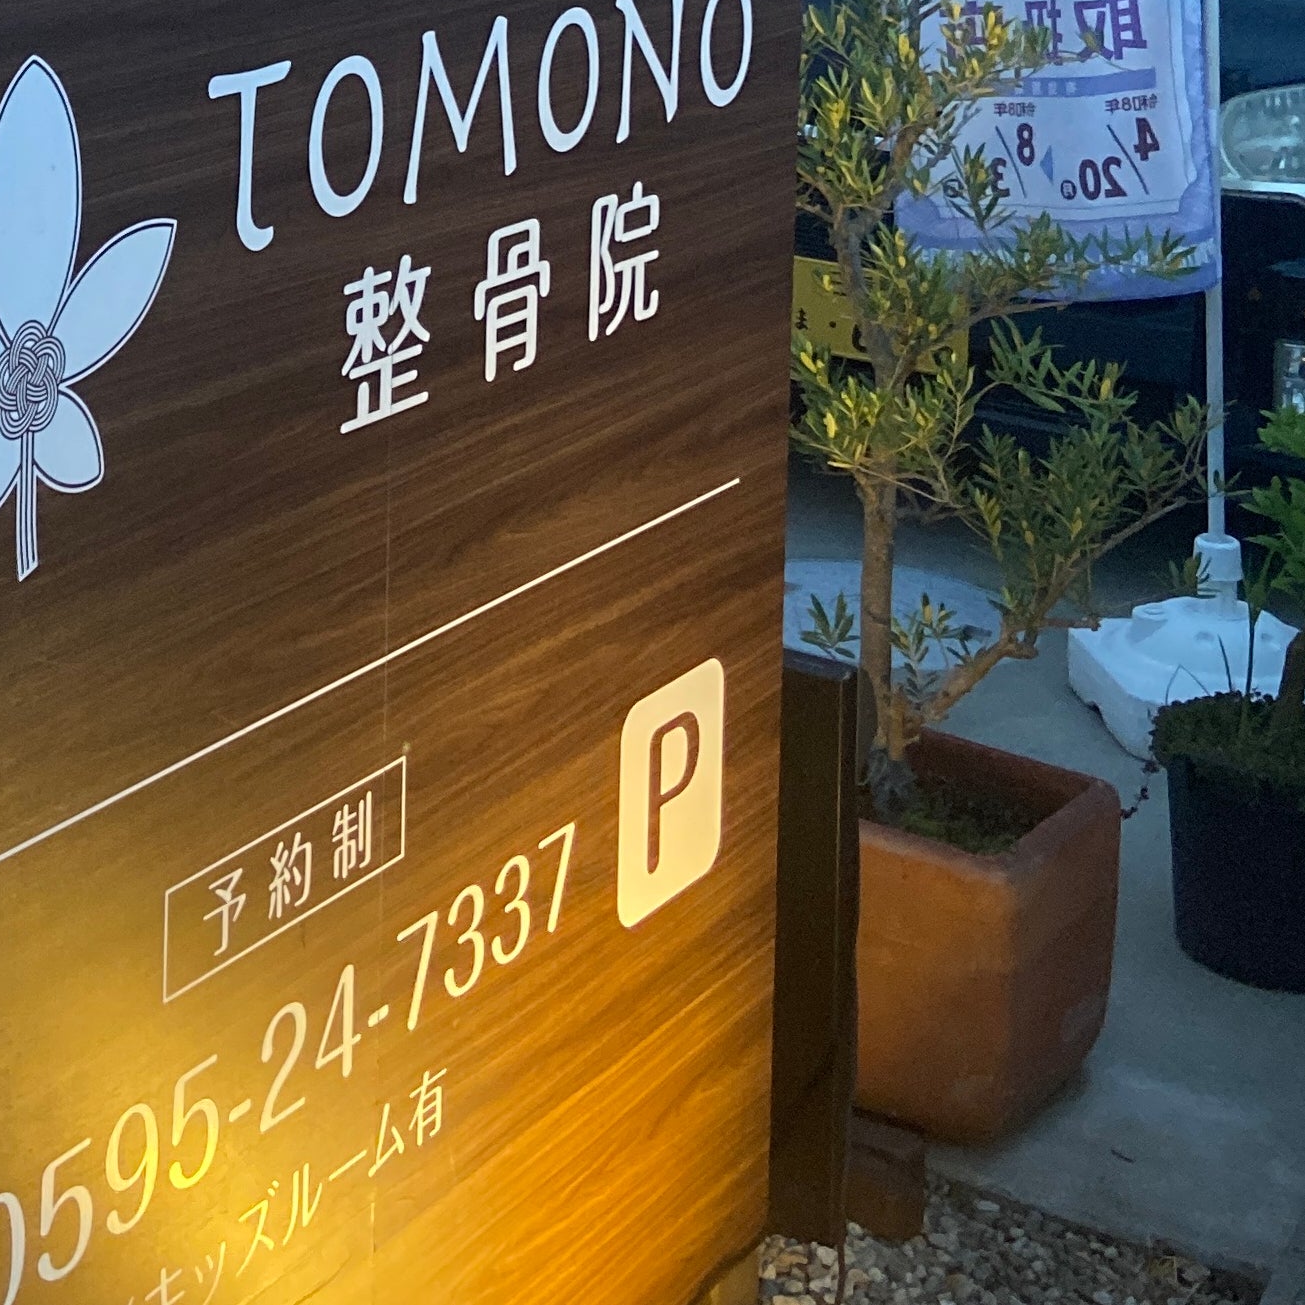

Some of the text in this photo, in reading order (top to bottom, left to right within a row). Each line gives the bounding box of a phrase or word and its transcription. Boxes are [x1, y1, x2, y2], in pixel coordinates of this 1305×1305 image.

[339, 180, 662, 435] 整骨院
[202, 789, 375, 959] 予約制
